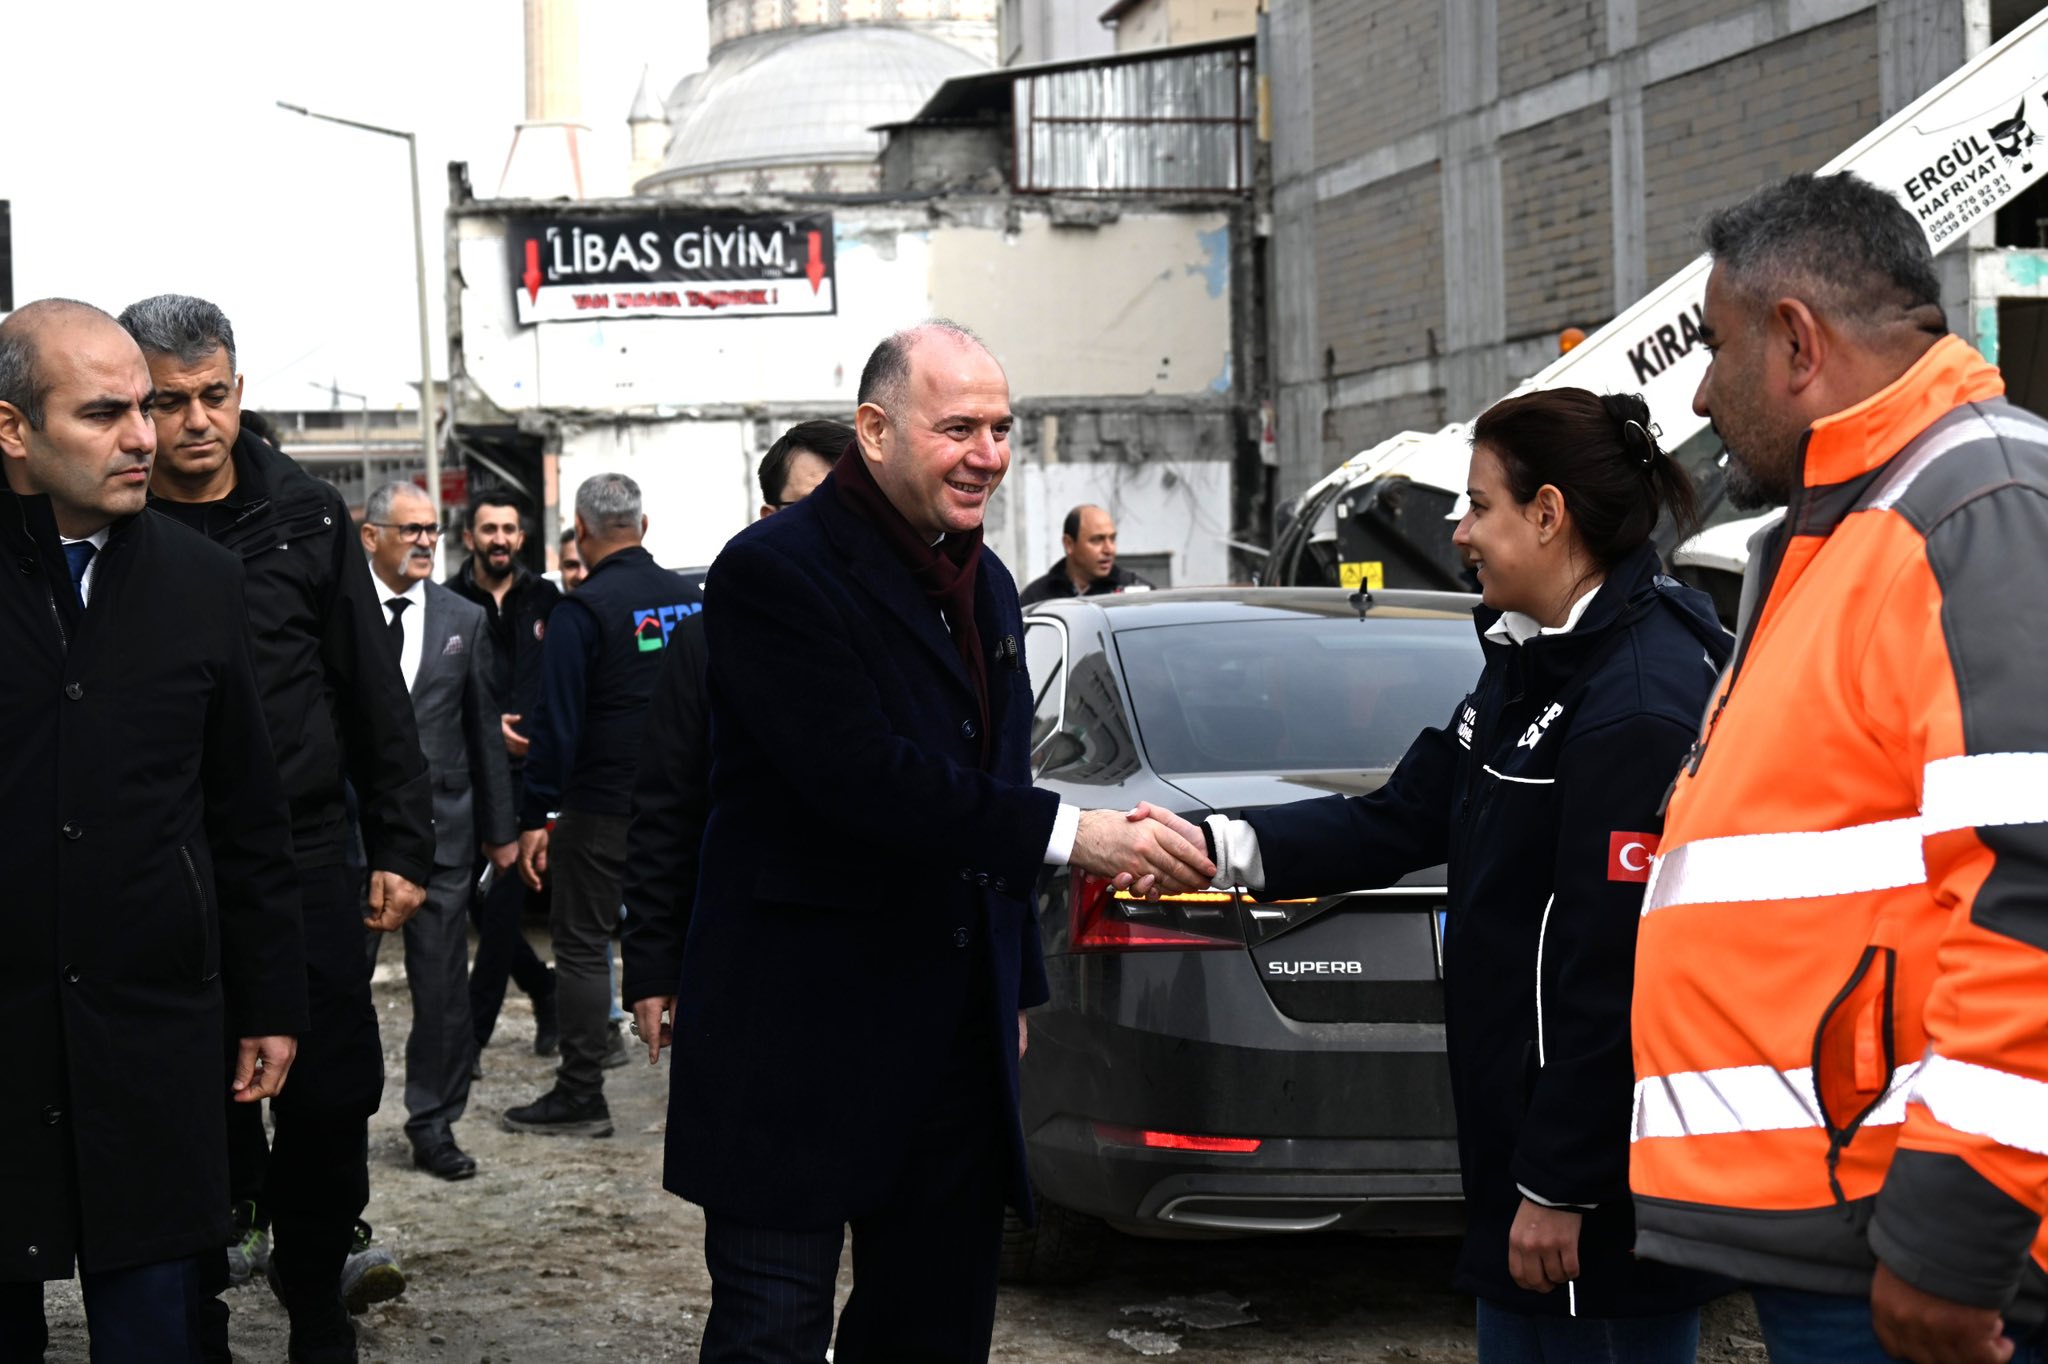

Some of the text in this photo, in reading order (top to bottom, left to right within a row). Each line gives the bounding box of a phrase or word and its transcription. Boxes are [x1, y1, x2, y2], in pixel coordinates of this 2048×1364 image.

[1903, 135, 1990, 202] ERGÜL
[1977, 184, 1992, 198] 92
[553, 224, 785, 275] LİBAS GİYİM
[1626, 302, 1705, 386] KİRA
[1268, 961, 1362, 975] SUPERB
